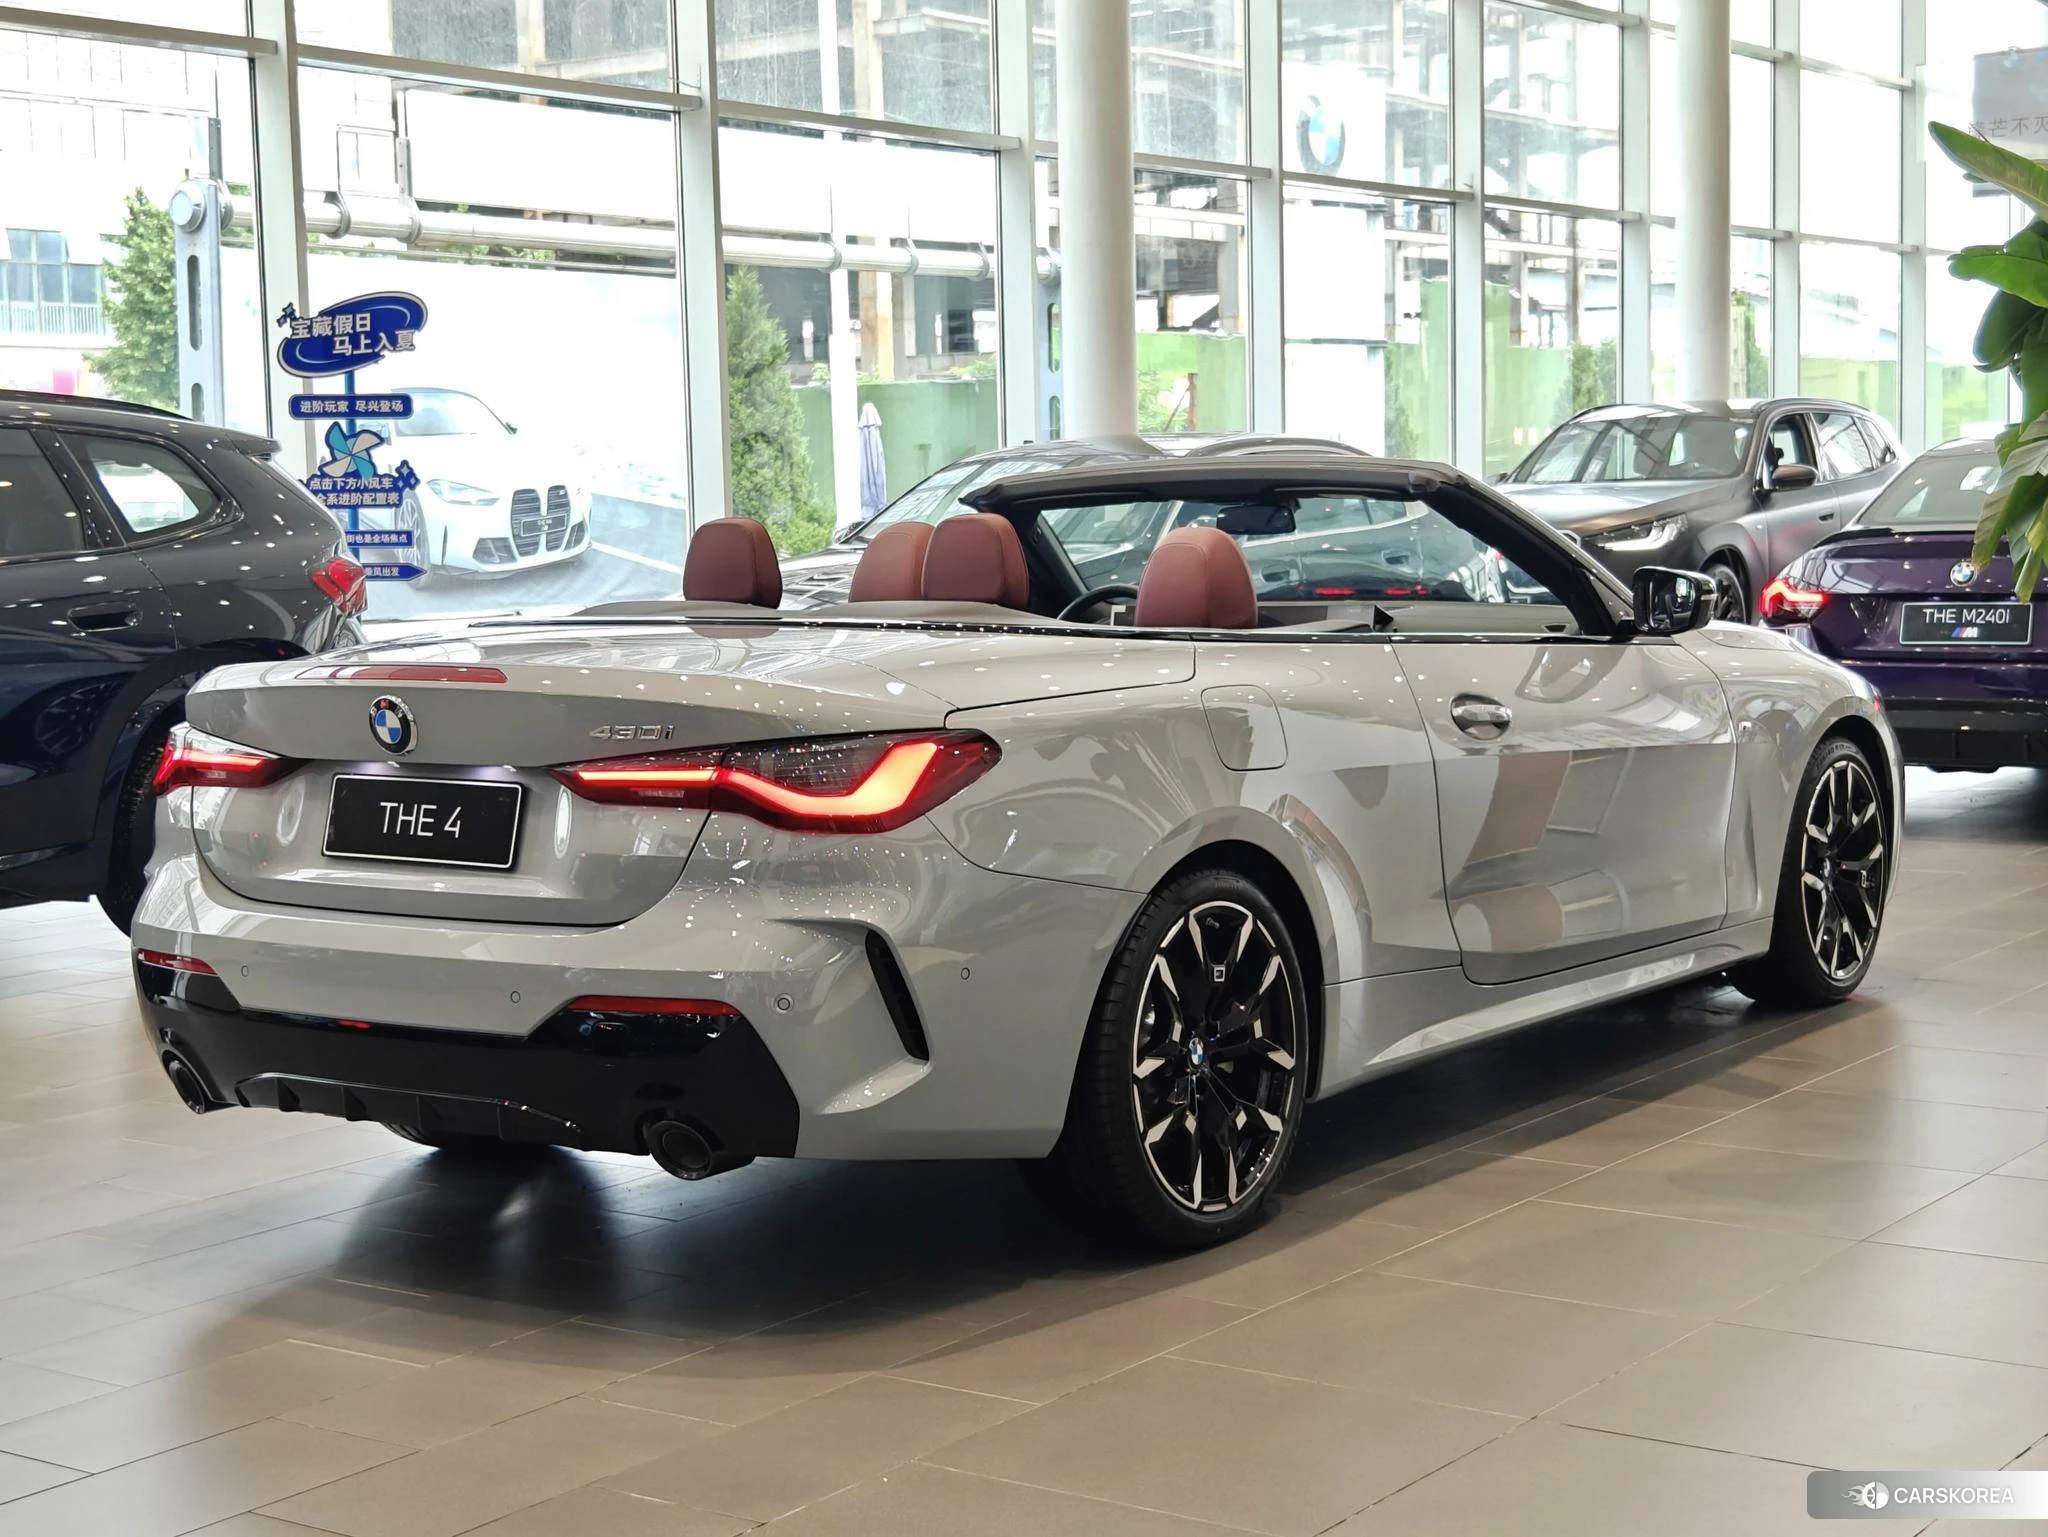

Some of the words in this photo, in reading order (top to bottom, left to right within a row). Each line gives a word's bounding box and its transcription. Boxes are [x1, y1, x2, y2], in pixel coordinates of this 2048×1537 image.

[291, 312, 371, 339] 宝藏假日
[333, 330, 416, 356] 马上入夏
[300, 401, 349, 412] 进阶玩家
[355, 401, 404, 412] 尽兴登场
[309, 478, 393, 490] 点击下方小风车
[1923, 608, 1956, 624] THE
[1962, 608, 2010, 624] M240i
[589, 724, 674, 741] 430i
[380, 801, 438, 837] THE
[444, 806, 462, 838] 4
